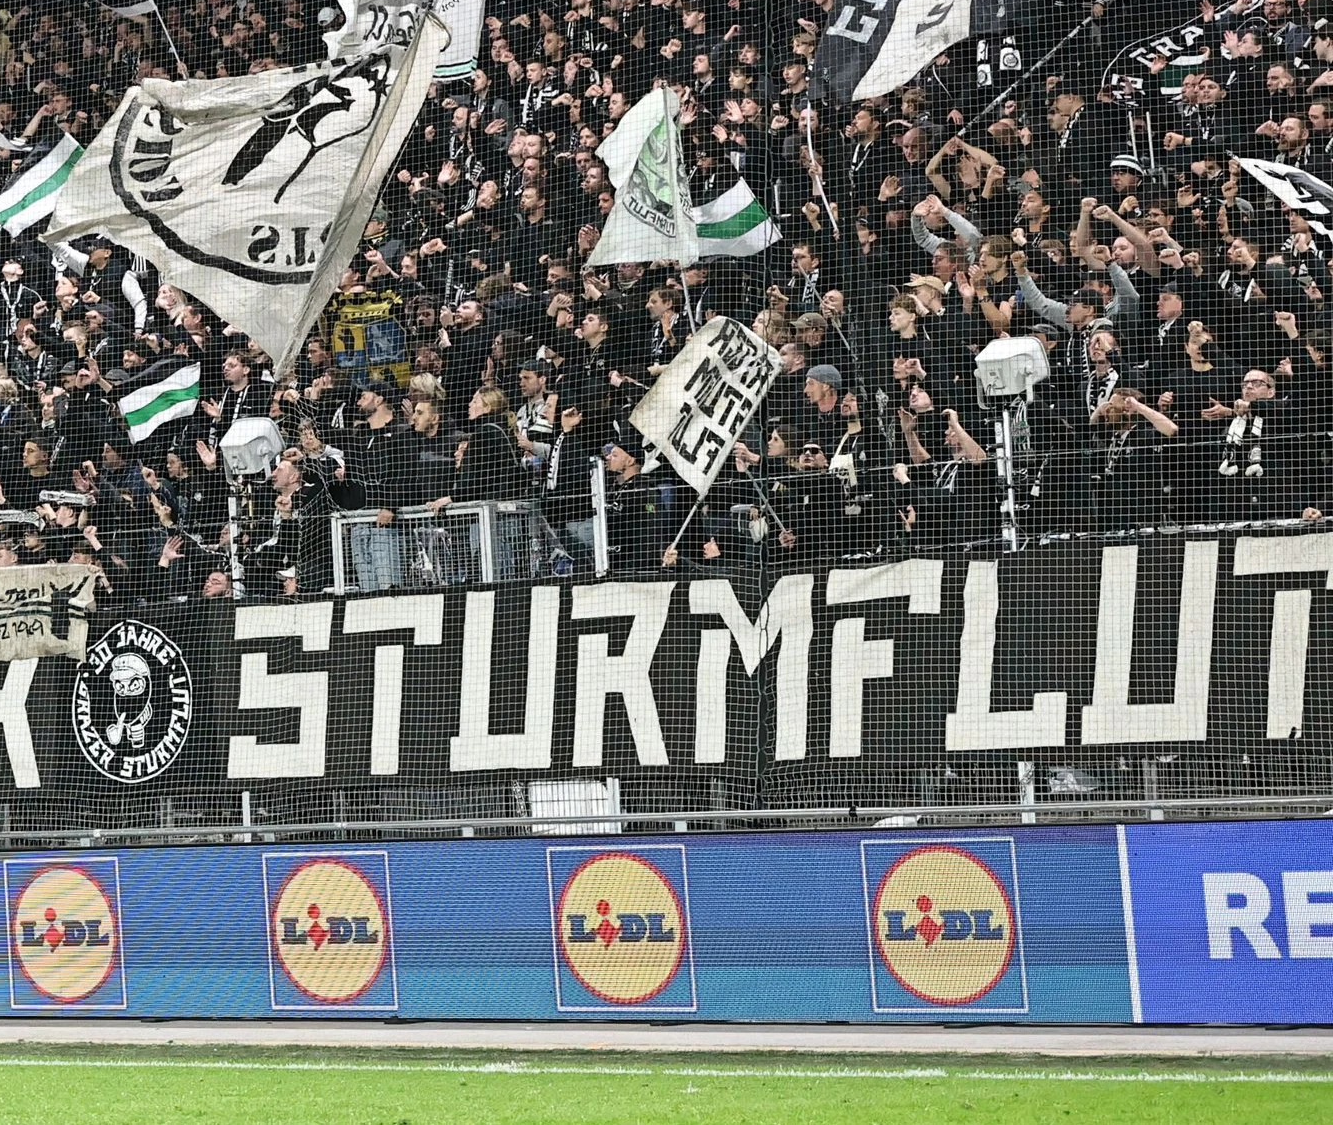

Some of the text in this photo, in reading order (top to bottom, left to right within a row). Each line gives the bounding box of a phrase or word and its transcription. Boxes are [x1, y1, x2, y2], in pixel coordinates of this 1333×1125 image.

[88, 625, 177, 675] 30 JAHRE
[228, 532, 1333, 778] STURMFLUT
[77, 680, 116, 771] GRAZER
[119, 674, 190, 778] STURMFLUT
